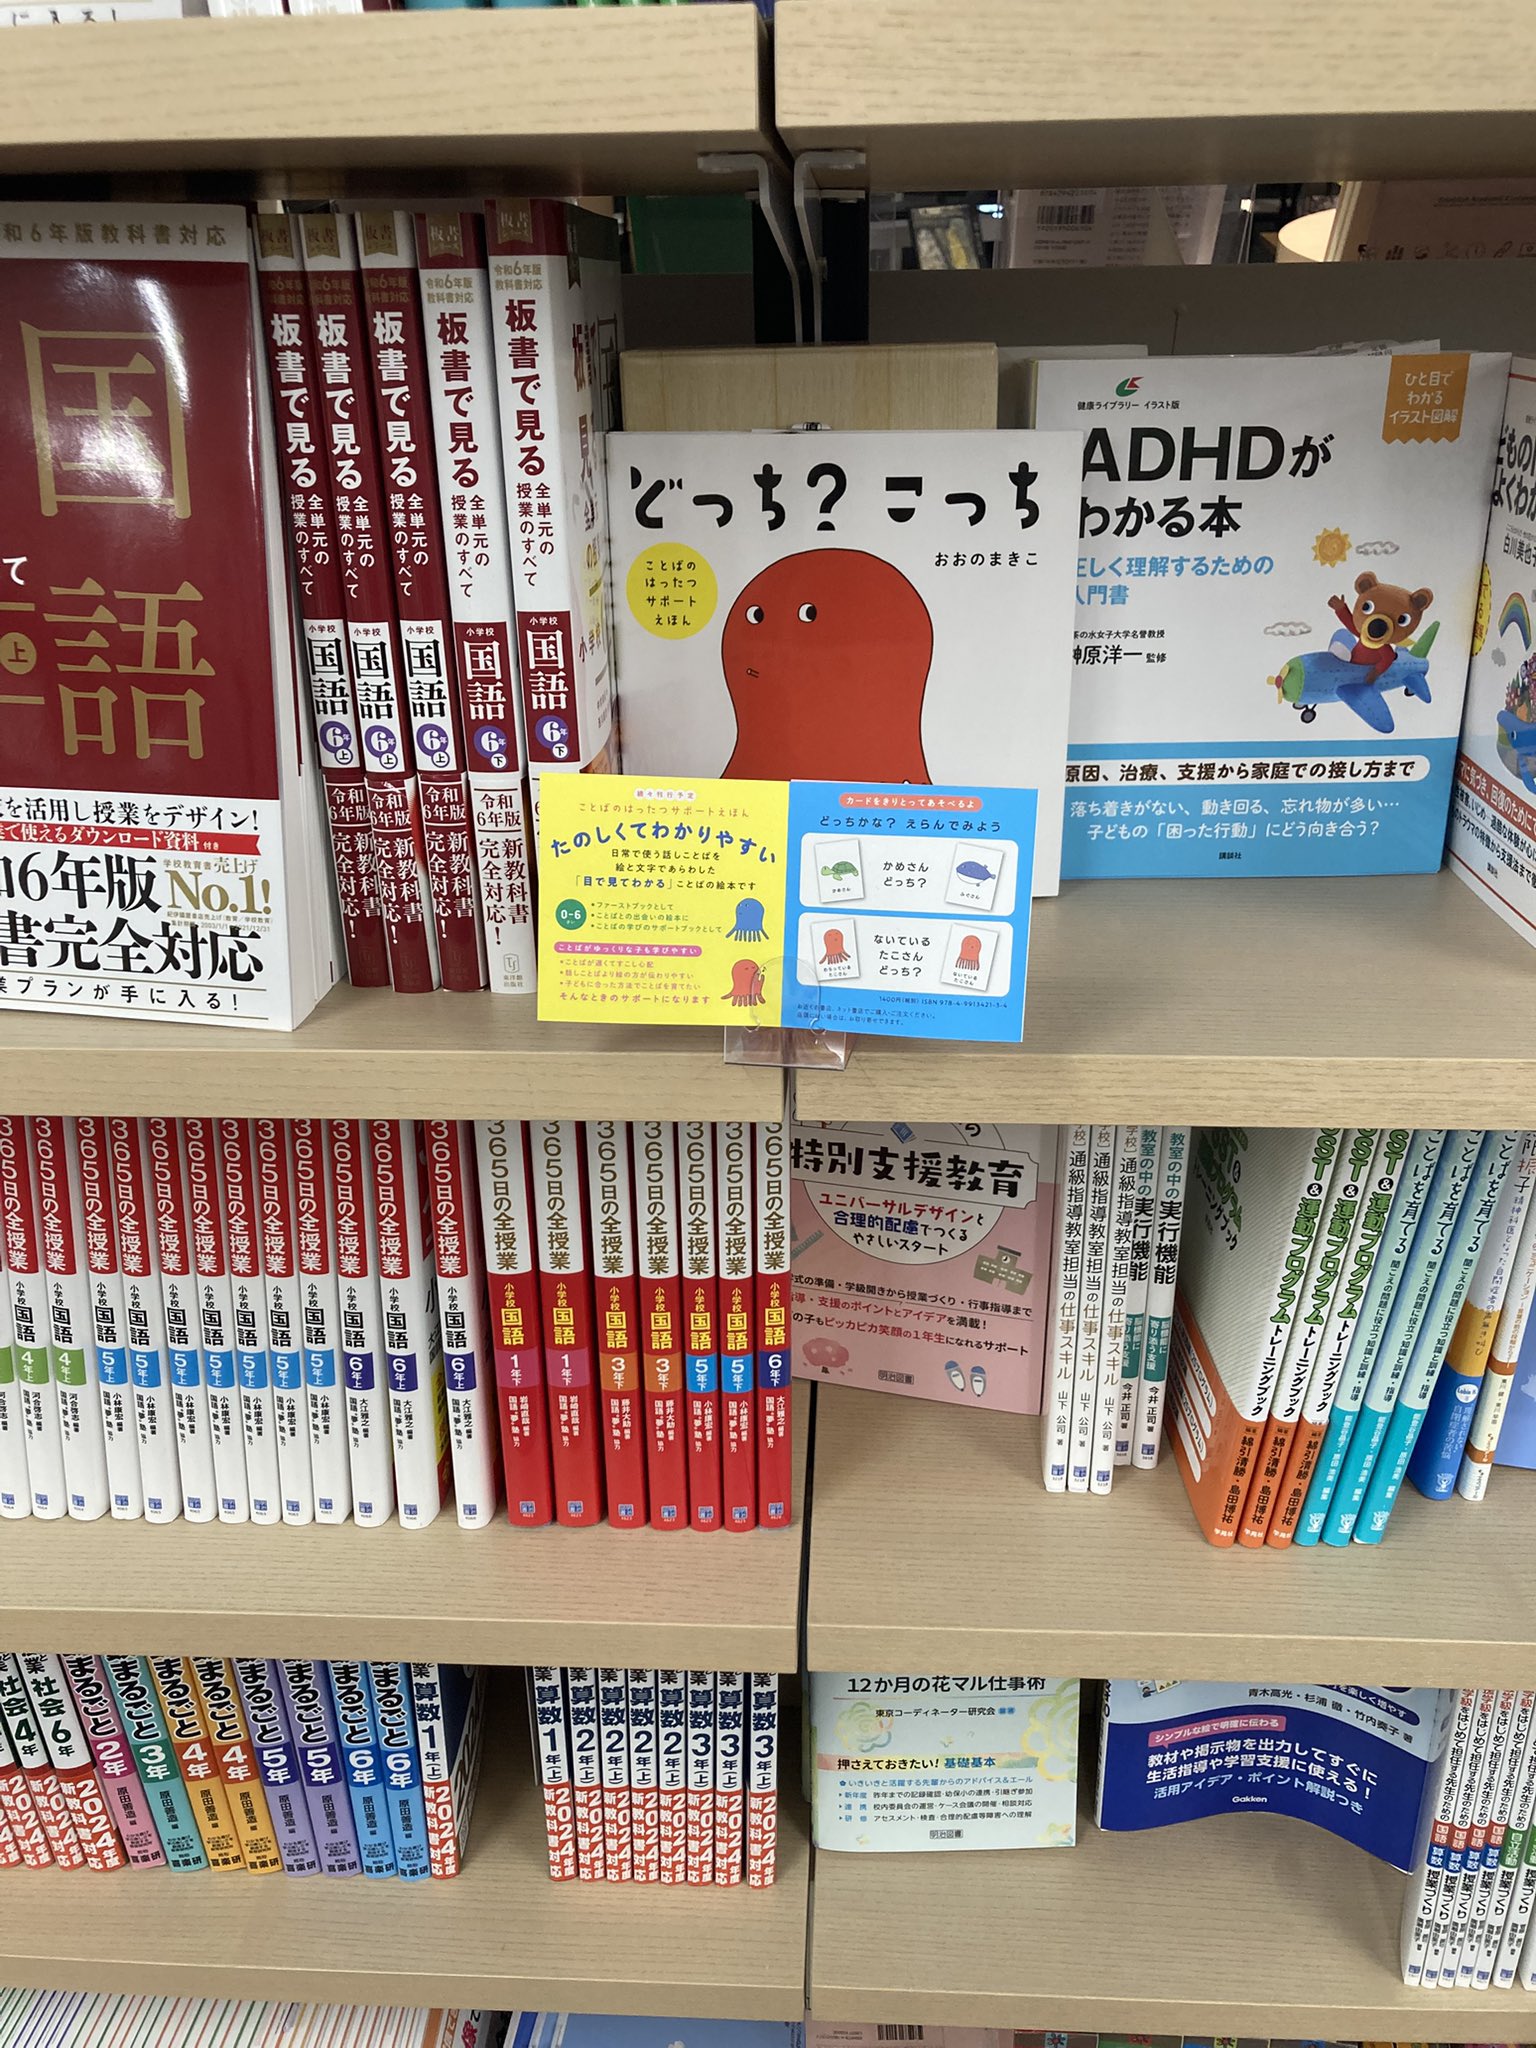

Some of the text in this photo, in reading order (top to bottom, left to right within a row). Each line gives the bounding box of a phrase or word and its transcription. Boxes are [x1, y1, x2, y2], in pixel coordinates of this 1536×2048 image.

[494, 261, 541, 275] 令和6年版
[495, 278, 542, 291] 教科書対応
[505, 299, 545, 476] 板書で見る
[1406, 371, 1452, 387] ひと目で
[271, 313, 317, 487] 板書で見る
[438, 313, 479, 487] 板書で見る
[1078, 401, 1180, 410] 健康ライブラリー イラスト版
[1407, 391, 1442, 405] わかる
[1390, 409, 1457, 424] イラスト図解
[630, 461, 1040, 531] どっち？ こっち
[1079, 495, 1242, 538] わかる本
[308, 494, 329, 565] 全単元の
[516, 483, 536, 586] 授業のすべて
[290, 494, 312, 595] 授業のすべて
[645, 560, 696, 571] ことばの
[935, 551, 1039, 567] おおのまきこ
[645, 576, 696, 588] はったつ
[646, 595, 696, 608] サポート
[308, 625, 336, 634] 小学校
[529, 616, 558, 625] 小学校
[656, 614, 691, 627] えほん
[526, 630, 568, 710] 国語
[1146, 653, 1167, 663] 監修
[307, 638, 349, 715] 国語
[0, 796, 259, 830] を活用し授業をデザイン！
[480, 794, 513, 809] 令和
[579, 803, 749, 818] ことばのはったつサポートえほん
[846, 797, 974, 809] カードをきりとってあそべるよ
[477, 812, 521, 827] 6年版
[820, 816, 1001, 832] どっちかな？ えらんでみよう
[0, 823, 219, 851] で使えるダウンロード資料 付き
[551, 821, 775, 863] たのしくてわかりやすい
[611, 849, 721, 861] 日常で使う話しことばを
[883, 861, 929, 871] かめさん
[1219, 851, 1241, 860] 講談社
[503, 837, 529, 923] 新教科書
[615, 863, 716, 874] 絵と文字であらわした
[165, 870, 271, 915] No.1!
[884, 877, 927, 888] どっち？
[561, 909, 581, 920] 0-6
[559, 944, 697, 954] ことばがゆっくりな子も学びやすい
[874, 935, 930, 946] ないている
[879, 950, 923, 962] たこさん
[879, 967, 922, 977] どっち？
[560, 992, 710, 1004] そんなときのサポートになります
[790, 1139, 1024, 1198] 特別支援教育
[36, 1117, 66, 1271] 365日の全授業
[78, 1118, 109, 1271] 365日の全授業
[333, 1120, 360, 1274] 365日の全授業
[820, 1193, 984, 1226] ユニバーサルデザインと
[833, 1211, 968, 1241] 合理的配慮でつくる
[853, 1233, 948, 1256] やさしいスタート
[1057, 1150, 1086, 1380] 通級指導教室担当の仕事スキル
[97, 1281, 107, 1306] 小学校
[609, 1286, 620, 1311] 小学校
[791, 1274, 1032, 1317] 式の準備・学級開きから授業づくり・行事指導まで
[95, 1306, 117, 1344] 国語
[502, 1307, 524, 1345] 国語
[605, 1311, 628, 1348] 国語
[510, 1355, 522, 1386] 1年下
[611, 1357, 625, 1390] 3年下
[31, 1677, 65, 1717] 社会
[848, 1676, 1045, 1693] 12か月の花マル仕事術
[536, 1685, 562, 1725] 算数
[753, 1691, 776, 1731] 算数
[876, 1708, 995, 1717] 東京コーディネーター研究会
[96, 1741, 128, 1776] 2年
[140, 1745, 170, 1779] 3年
[350, 1750, 375, 1785] 6年
[944, 1757, 995, 1768] 基礎基本
